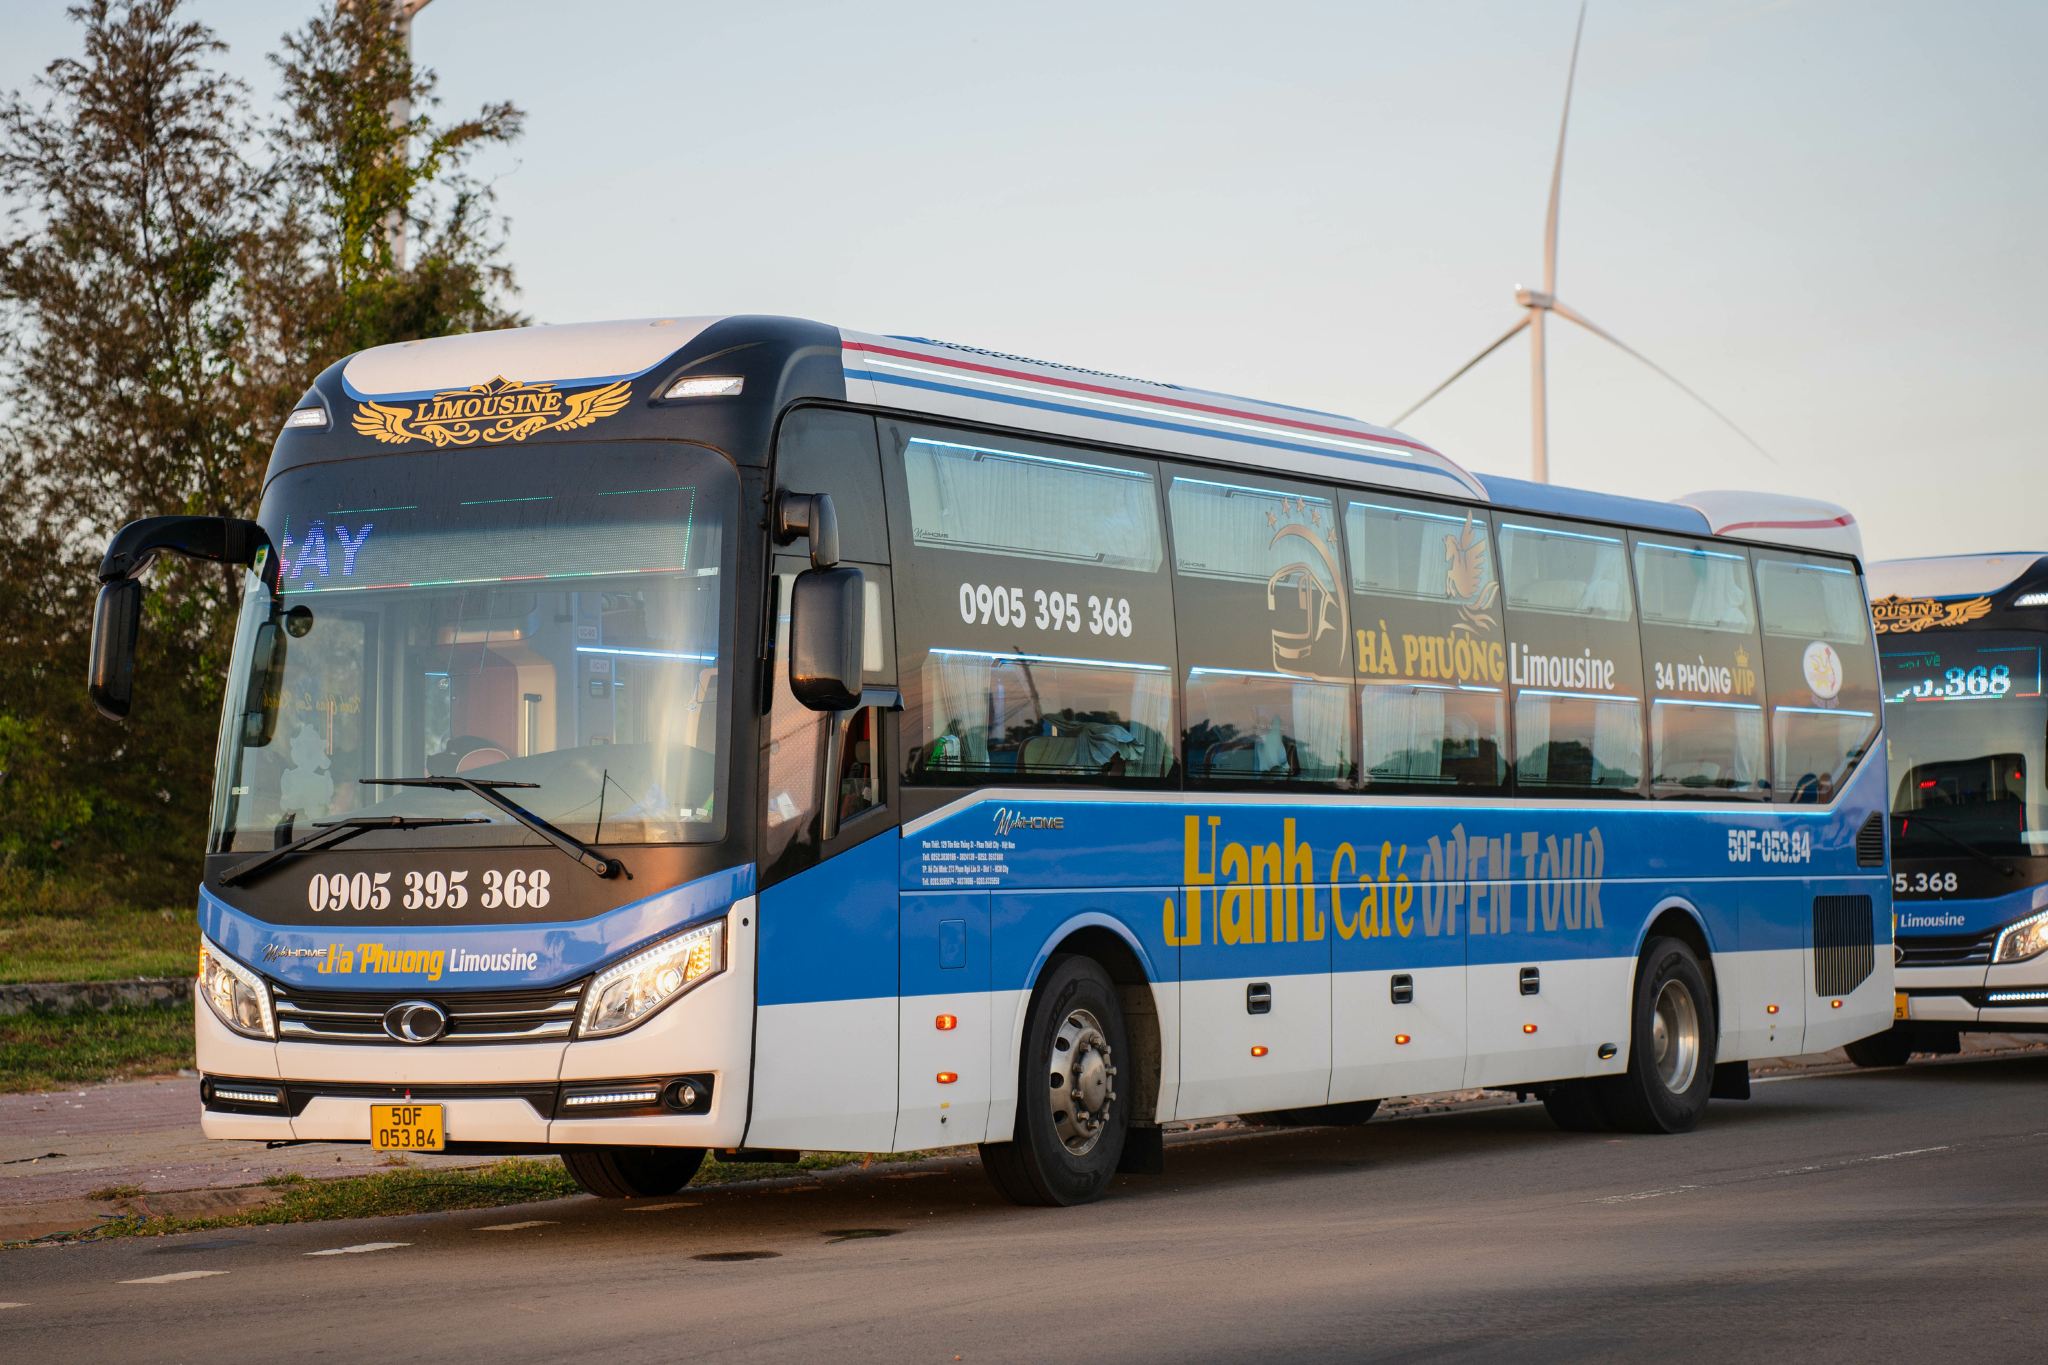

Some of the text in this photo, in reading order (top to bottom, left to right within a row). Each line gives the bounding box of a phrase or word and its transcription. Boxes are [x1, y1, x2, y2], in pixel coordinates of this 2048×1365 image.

[414, 392, 562, 422] LIMOUSINE
[959, 582, 1132, 638] 0905 395 368
[1871, 602, 1944, 618] OUSINE
[1356, 619, 1398, 676] HÀ
[1510, 642, 1615, 690] Limousine
[1655, 654, 1756, 696] 34 PHÒNG VIP
[1728, 829, 1812, 864] 50F-053.84
[308, 868, 551, 913] 0905 395 368
[1163, 815, 1604, 946] Hanh Café OPEN TOUR
[1892, 872, 1958, 892] 5.368
[1900, 911, 1966, 928] Limousine
[318, 943, 539, 982] Ha Phuong Limousine
[379, 1106, 436, 1149] 50F 053.84
